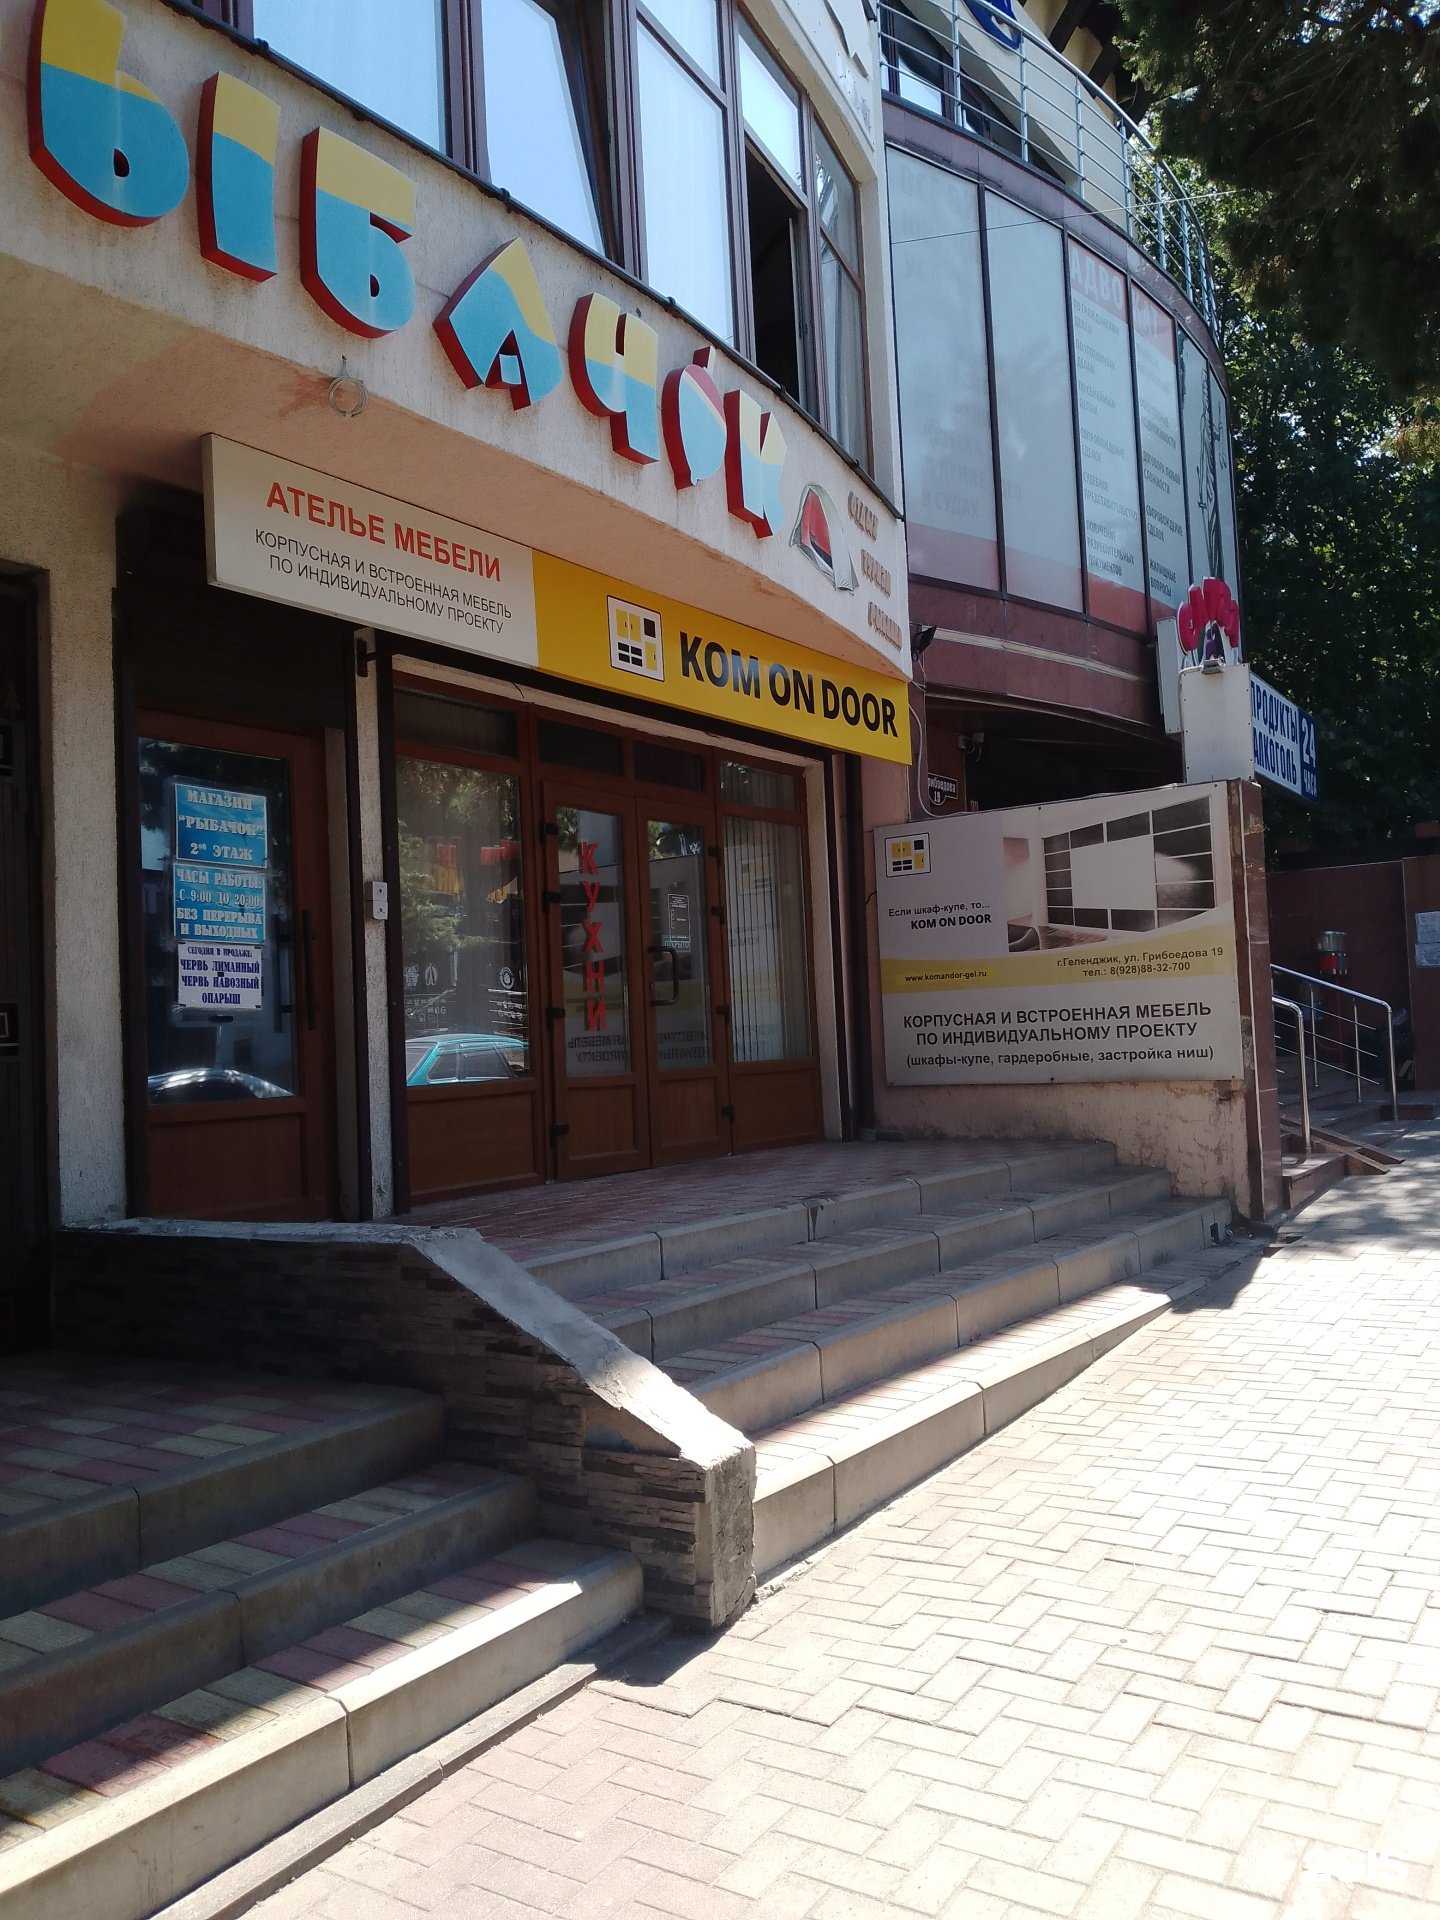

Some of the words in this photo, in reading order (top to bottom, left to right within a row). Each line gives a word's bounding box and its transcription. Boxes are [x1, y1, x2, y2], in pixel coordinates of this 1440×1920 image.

[266, 482, 385, 544] АТЕЛЬЕ
[394, 521, 501, 581] МЕБЕЛИ
[255, 529, 350, 569] КОРПУСНАЯ
[355, 560, 365, 575] И
[369, 563, 459, 602] ВСТРОЕННАЯ
[463, 591, 512, 619] МЕБЕЛЬ
[269, 554, 293, 574] ПО
[298, 562, 444, 617] ИНДИВИДУАЛЬНОМУ
[448, 607, 504, 634] ПРОЕКТУ
[680, 632, 760, 699] KOM
[769, 664, 816, 714] ON
[821, 680, 899, 738] DOOR
[1250, 680, 1298, 744] ПРОДУКТЫ
[1302, 717, 1316, 768] 24
[1253, 726, 1297, 786] АЛКОГОЛЬ
[187, 790, 256, 811] МАГАЗИН
[212, 844, 253, 861] ЭТАЖ
[176, 868, 209, 884] ЧАСЫ
[176, 907, 198, 920] БЕЗ
[888, 908, 911, 917] Если
[914, 902, 968, 915] шкаф-купе,
[911, 919, 937, 930] KOM
[938, 916, 956, 927] ON
[958, 914, 992, 926] DOOR
[580, 841, 607, 1031] КУХНИ
[180, 959, 209, 971] ЧЕРВЬ
[212, 960, 260, 974] ЛИМАННЫЙ
[1124, 954, 1140, 964] ул.
[1142, 949, 1208, 962] Грибоедова
[1211, 947, 1224, 956] 19
[181, 975, 210, 988] ЧЕРВЬ
[904, 970, 987, 982] www.komandor-gel.ru
[201, 992, 241, 1005] ОПАРЫШ
[903, 1011, 996, 1028] КОРПУСНАЯ
[1001, 1011, 1011, 1024] И
[1016, 1005, 1130, 1024] ВСТРОЕННАЯ
[1136, 1001, 1212, 1019] МЕБЕЛЬ
[916, 1032, 938, 1045] ПО
[942, 1026, 1110, 1046] ИНДИВИДУАЛЬНОМУ
[1116, 1022, 1197, 1039] ПРОЕКТУ
[906, 1053, 994, 1068] (шкафы-купе,
[998, 1050, 1094, 1065] гардеробные,
[1097, 1048, 1172, 1063] застройка
[1177, 1045, 1214, 1060] ниш)
